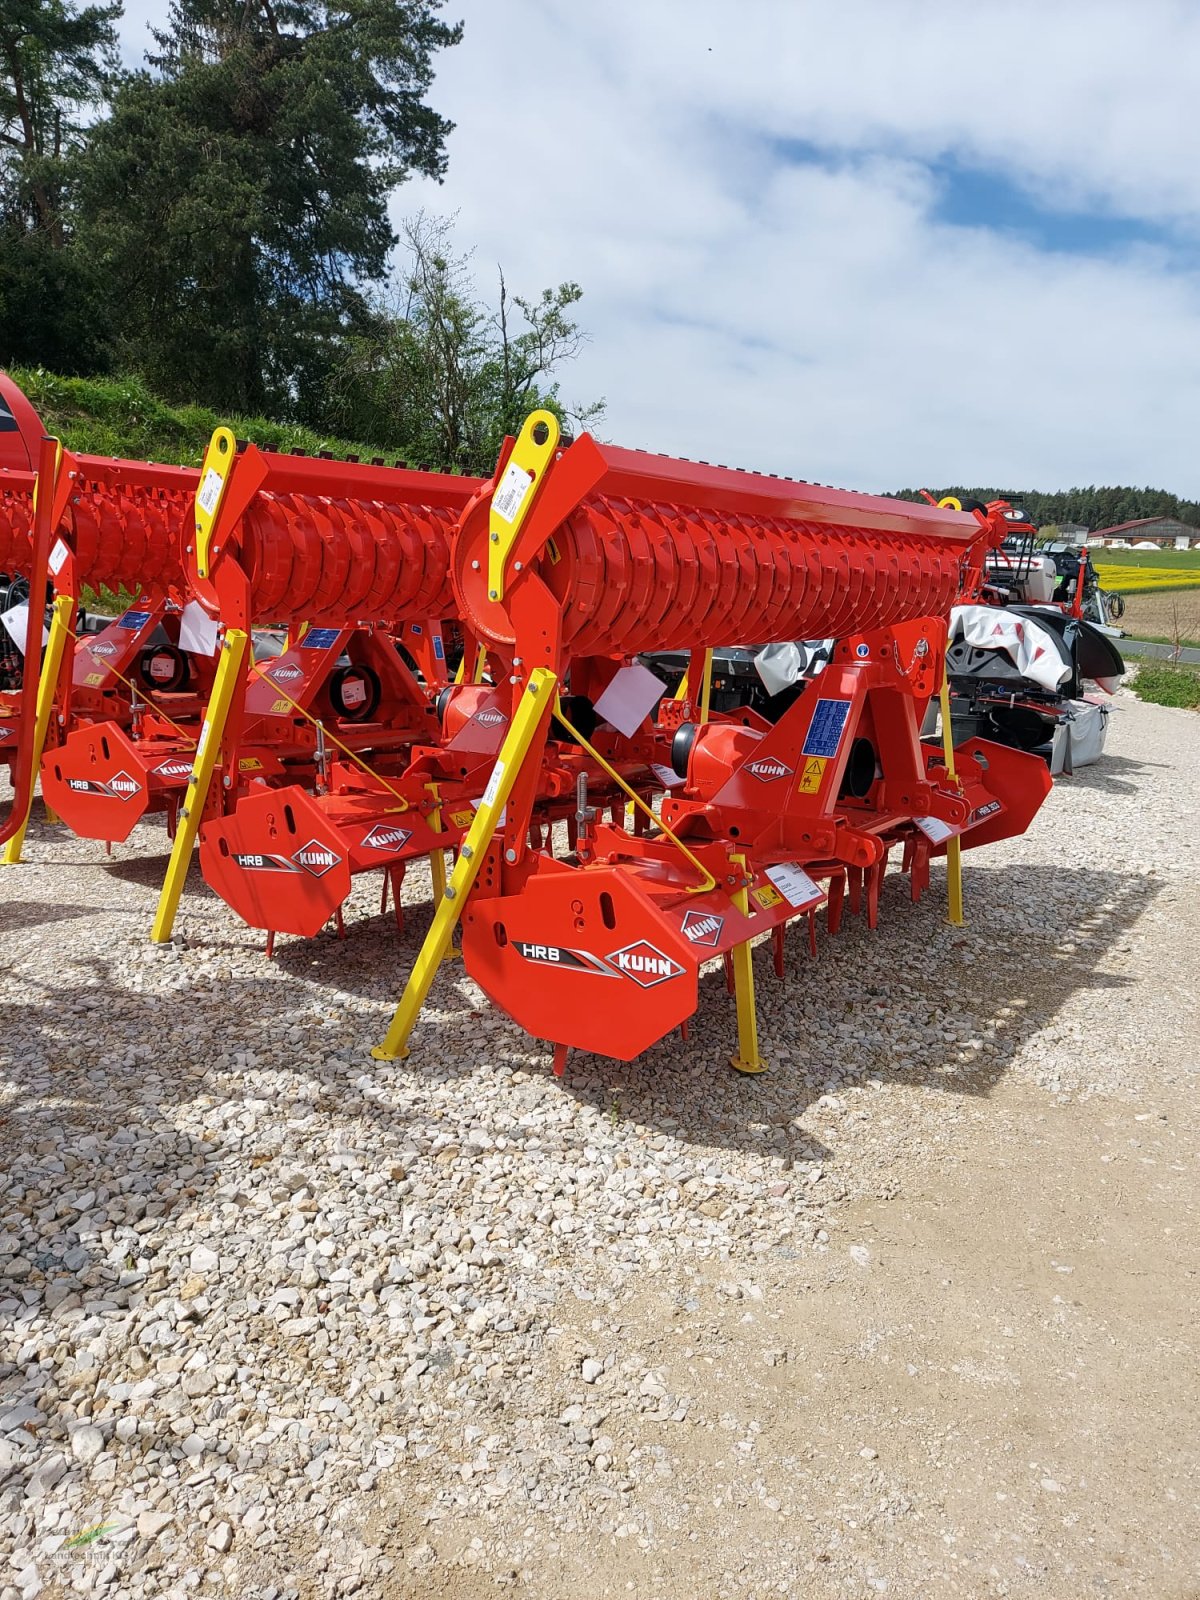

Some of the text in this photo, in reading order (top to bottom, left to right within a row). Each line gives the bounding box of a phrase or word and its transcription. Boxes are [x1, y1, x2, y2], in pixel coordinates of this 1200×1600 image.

[92, 645, 114, 654] KUHN
[274, 669, 299, 678] KUHN
[478, 713, 503, 722] KUHN
[160, 763, 194, 775] KUHN
[751, 764, 786, 776] KUHN
[70, 779, 89, 790] HRB
[111, 780, 136, 792] KUHN
[368, 830, 406, 848] KUHN
[238, 855, 263, 867] HRB
[300, 852, 333, 866] KUHN
[684, 917, 720, 941] KUHN
[522, 943, 560, 962] HRB
[618, 953, 672, 976] KUHN
